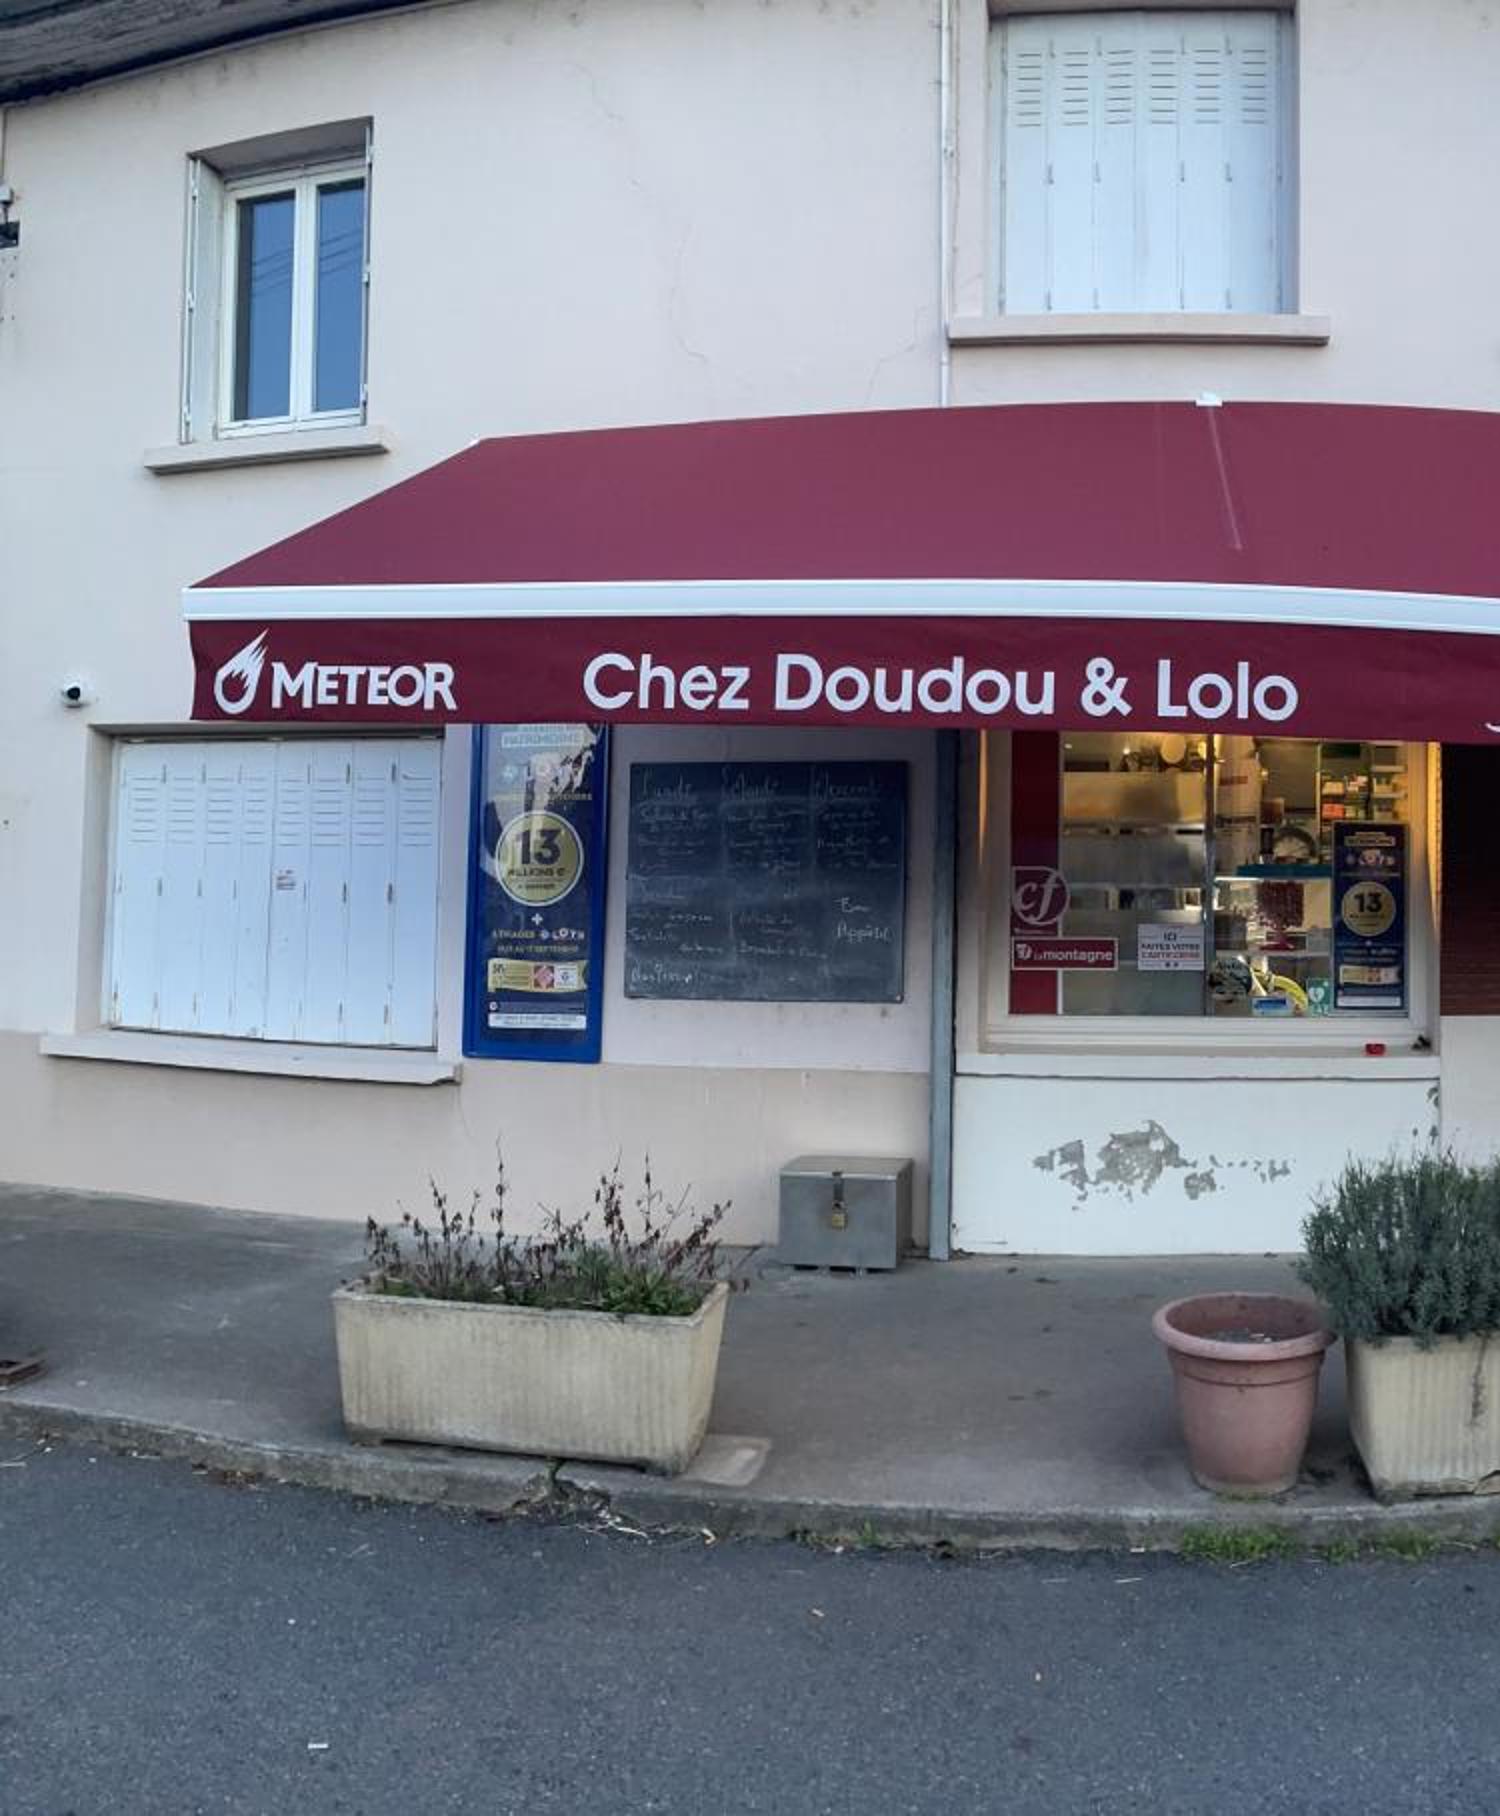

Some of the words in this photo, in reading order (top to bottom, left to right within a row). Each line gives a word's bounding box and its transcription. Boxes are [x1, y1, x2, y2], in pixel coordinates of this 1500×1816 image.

[271, 661, 458, 711] METEOR
[583, 652, 750, 710] Chez
[774, 653, 1055, 715] Doudou
[1080, 656, 1133, 716] &
[1157, 659, 1299, 722] Lolo
[515, 829, 562, 865] 13
[1354, 892, 1383, 914] 13
[1043, 949, 1113, 963] montagne
